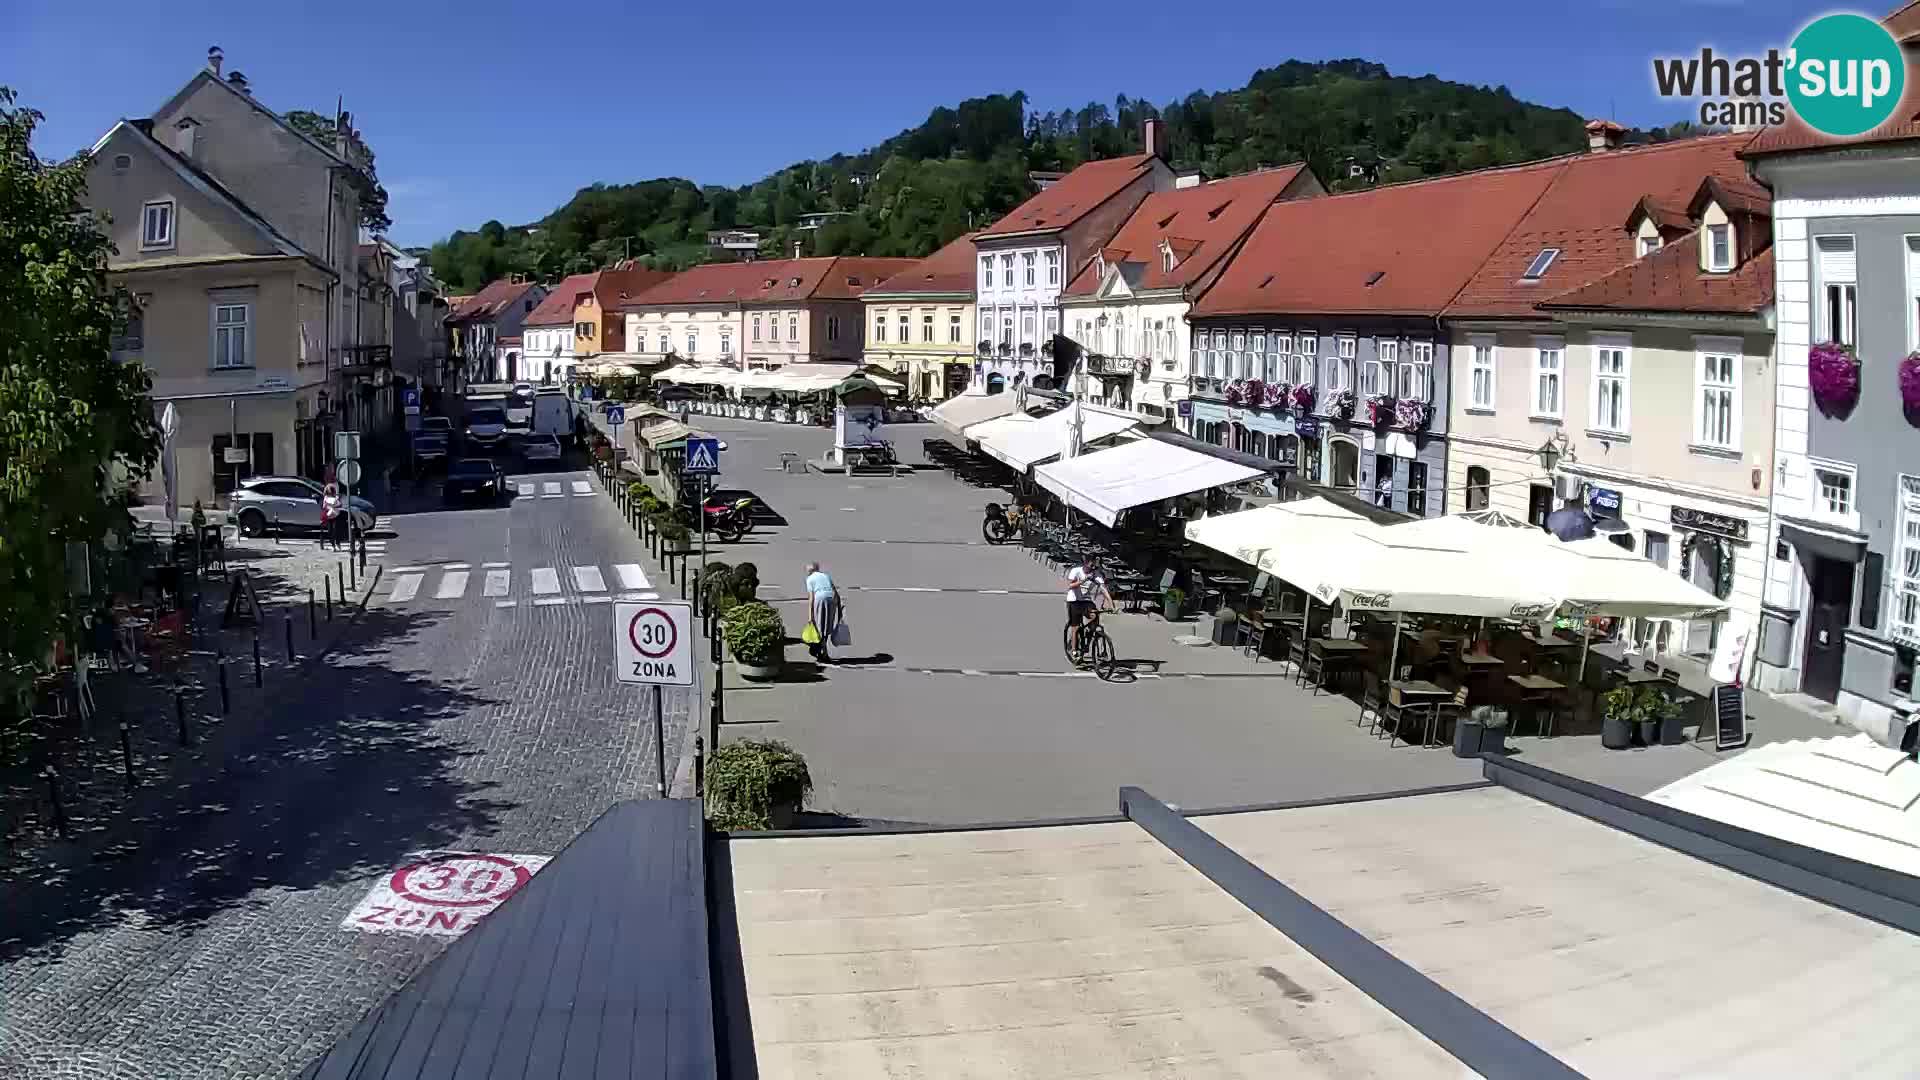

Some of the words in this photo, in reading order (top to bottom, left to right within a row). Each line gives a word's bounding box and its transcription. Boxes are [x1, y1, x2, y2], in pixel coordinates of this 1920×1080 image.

[642, 624, 666, 645] 30
[632, 662, 676, 677] ZONA
[418, 866, 503, 893] 30
[357, 906, 474, 930] ZON
